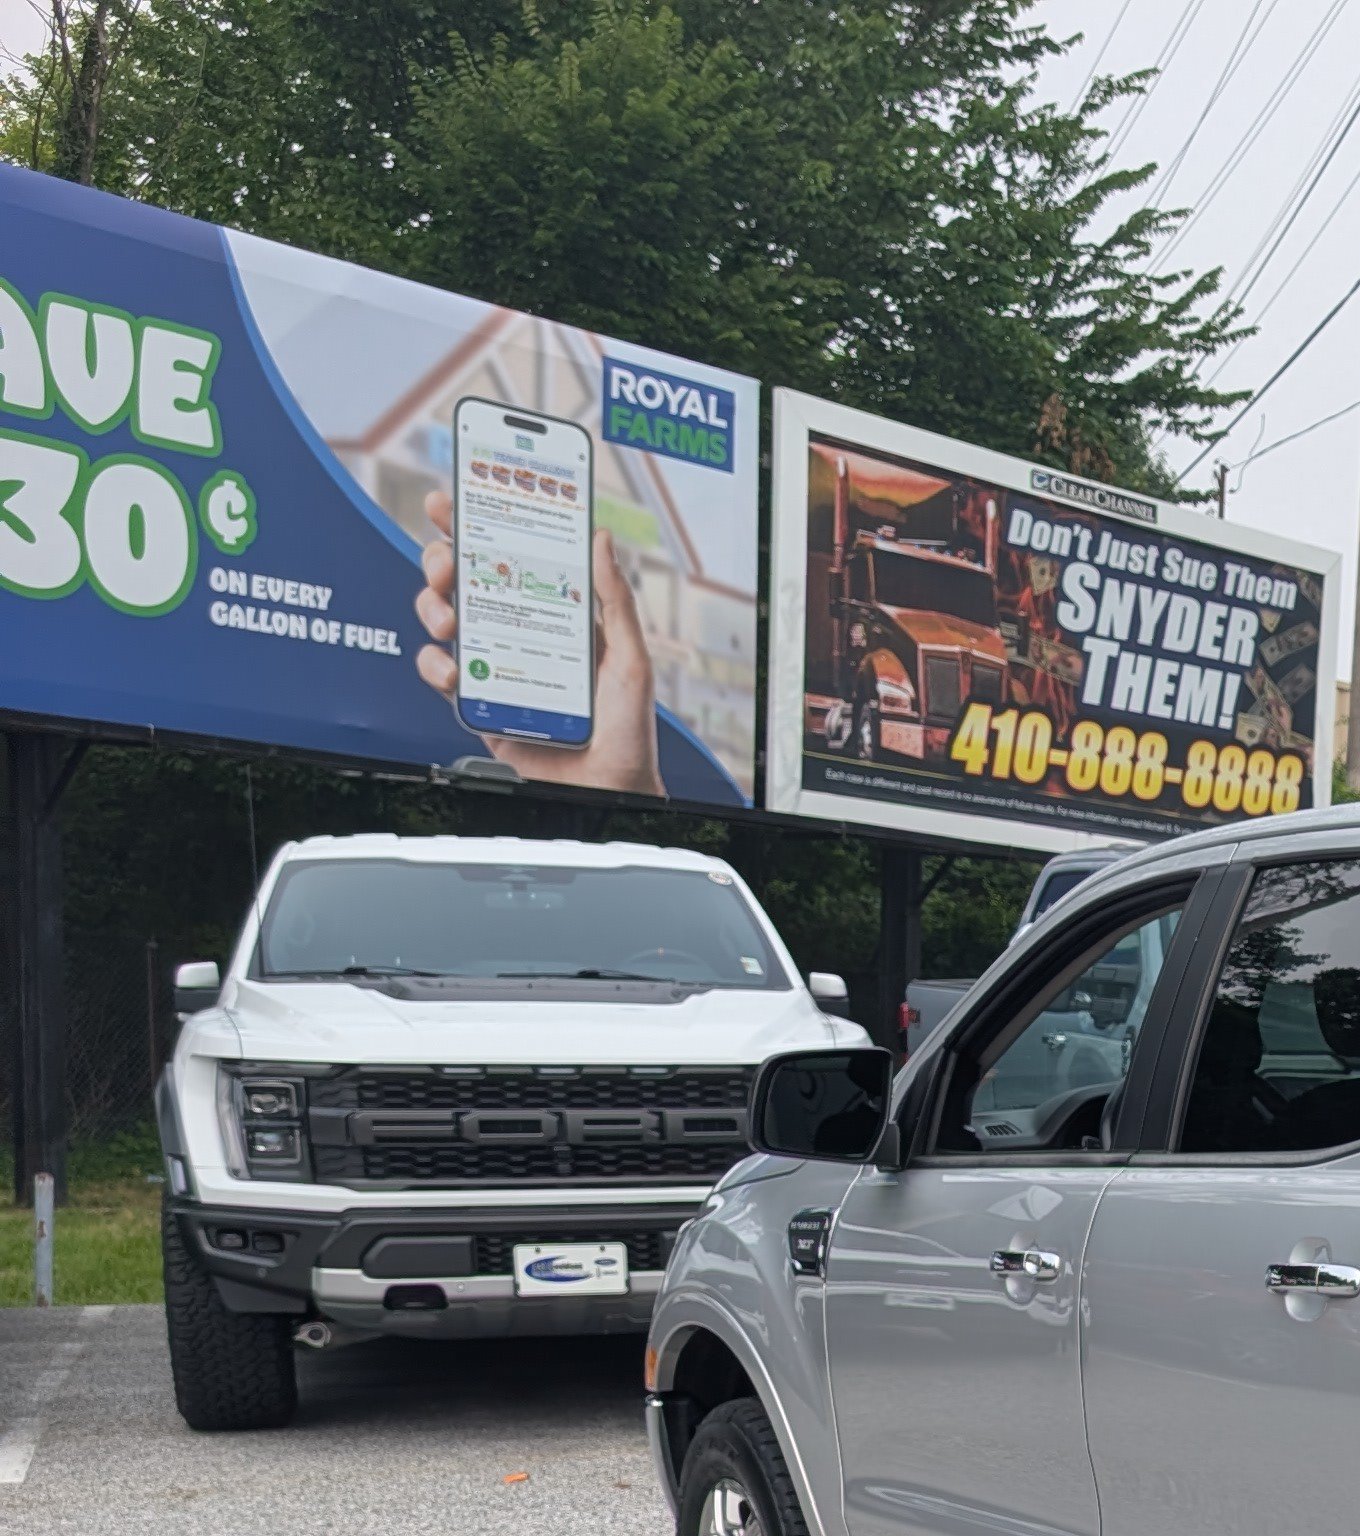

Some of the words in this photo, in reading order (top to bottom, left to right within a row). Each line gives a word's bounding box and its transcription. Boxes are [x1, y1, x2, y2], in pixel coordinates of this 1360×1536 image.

[609, 366, 728, 430] ROYAL
[608, 407, 727, 466] FARMS
[210, 568, 248, 596] ON
[252, 575, 332, 611] EVERY
[1007, 508, 1093, 561] Don't
[1094, 531, 1160, 577] Just
[1162, 548, 1218, 591] Sue
[1223, 562, 1298, 610] Them
[209, 602, 308, 640] GALLON
[312, 617, 342, 644] OF
[345, 623, 401, 655] FUEL
[1057, 561, 1259, 667] SNYDER
[1082, 636, 1242, 730] THEM!
[951, 702, 1304, 815] 410-888-8888
[349, 1109, 750, 1147] FORD
